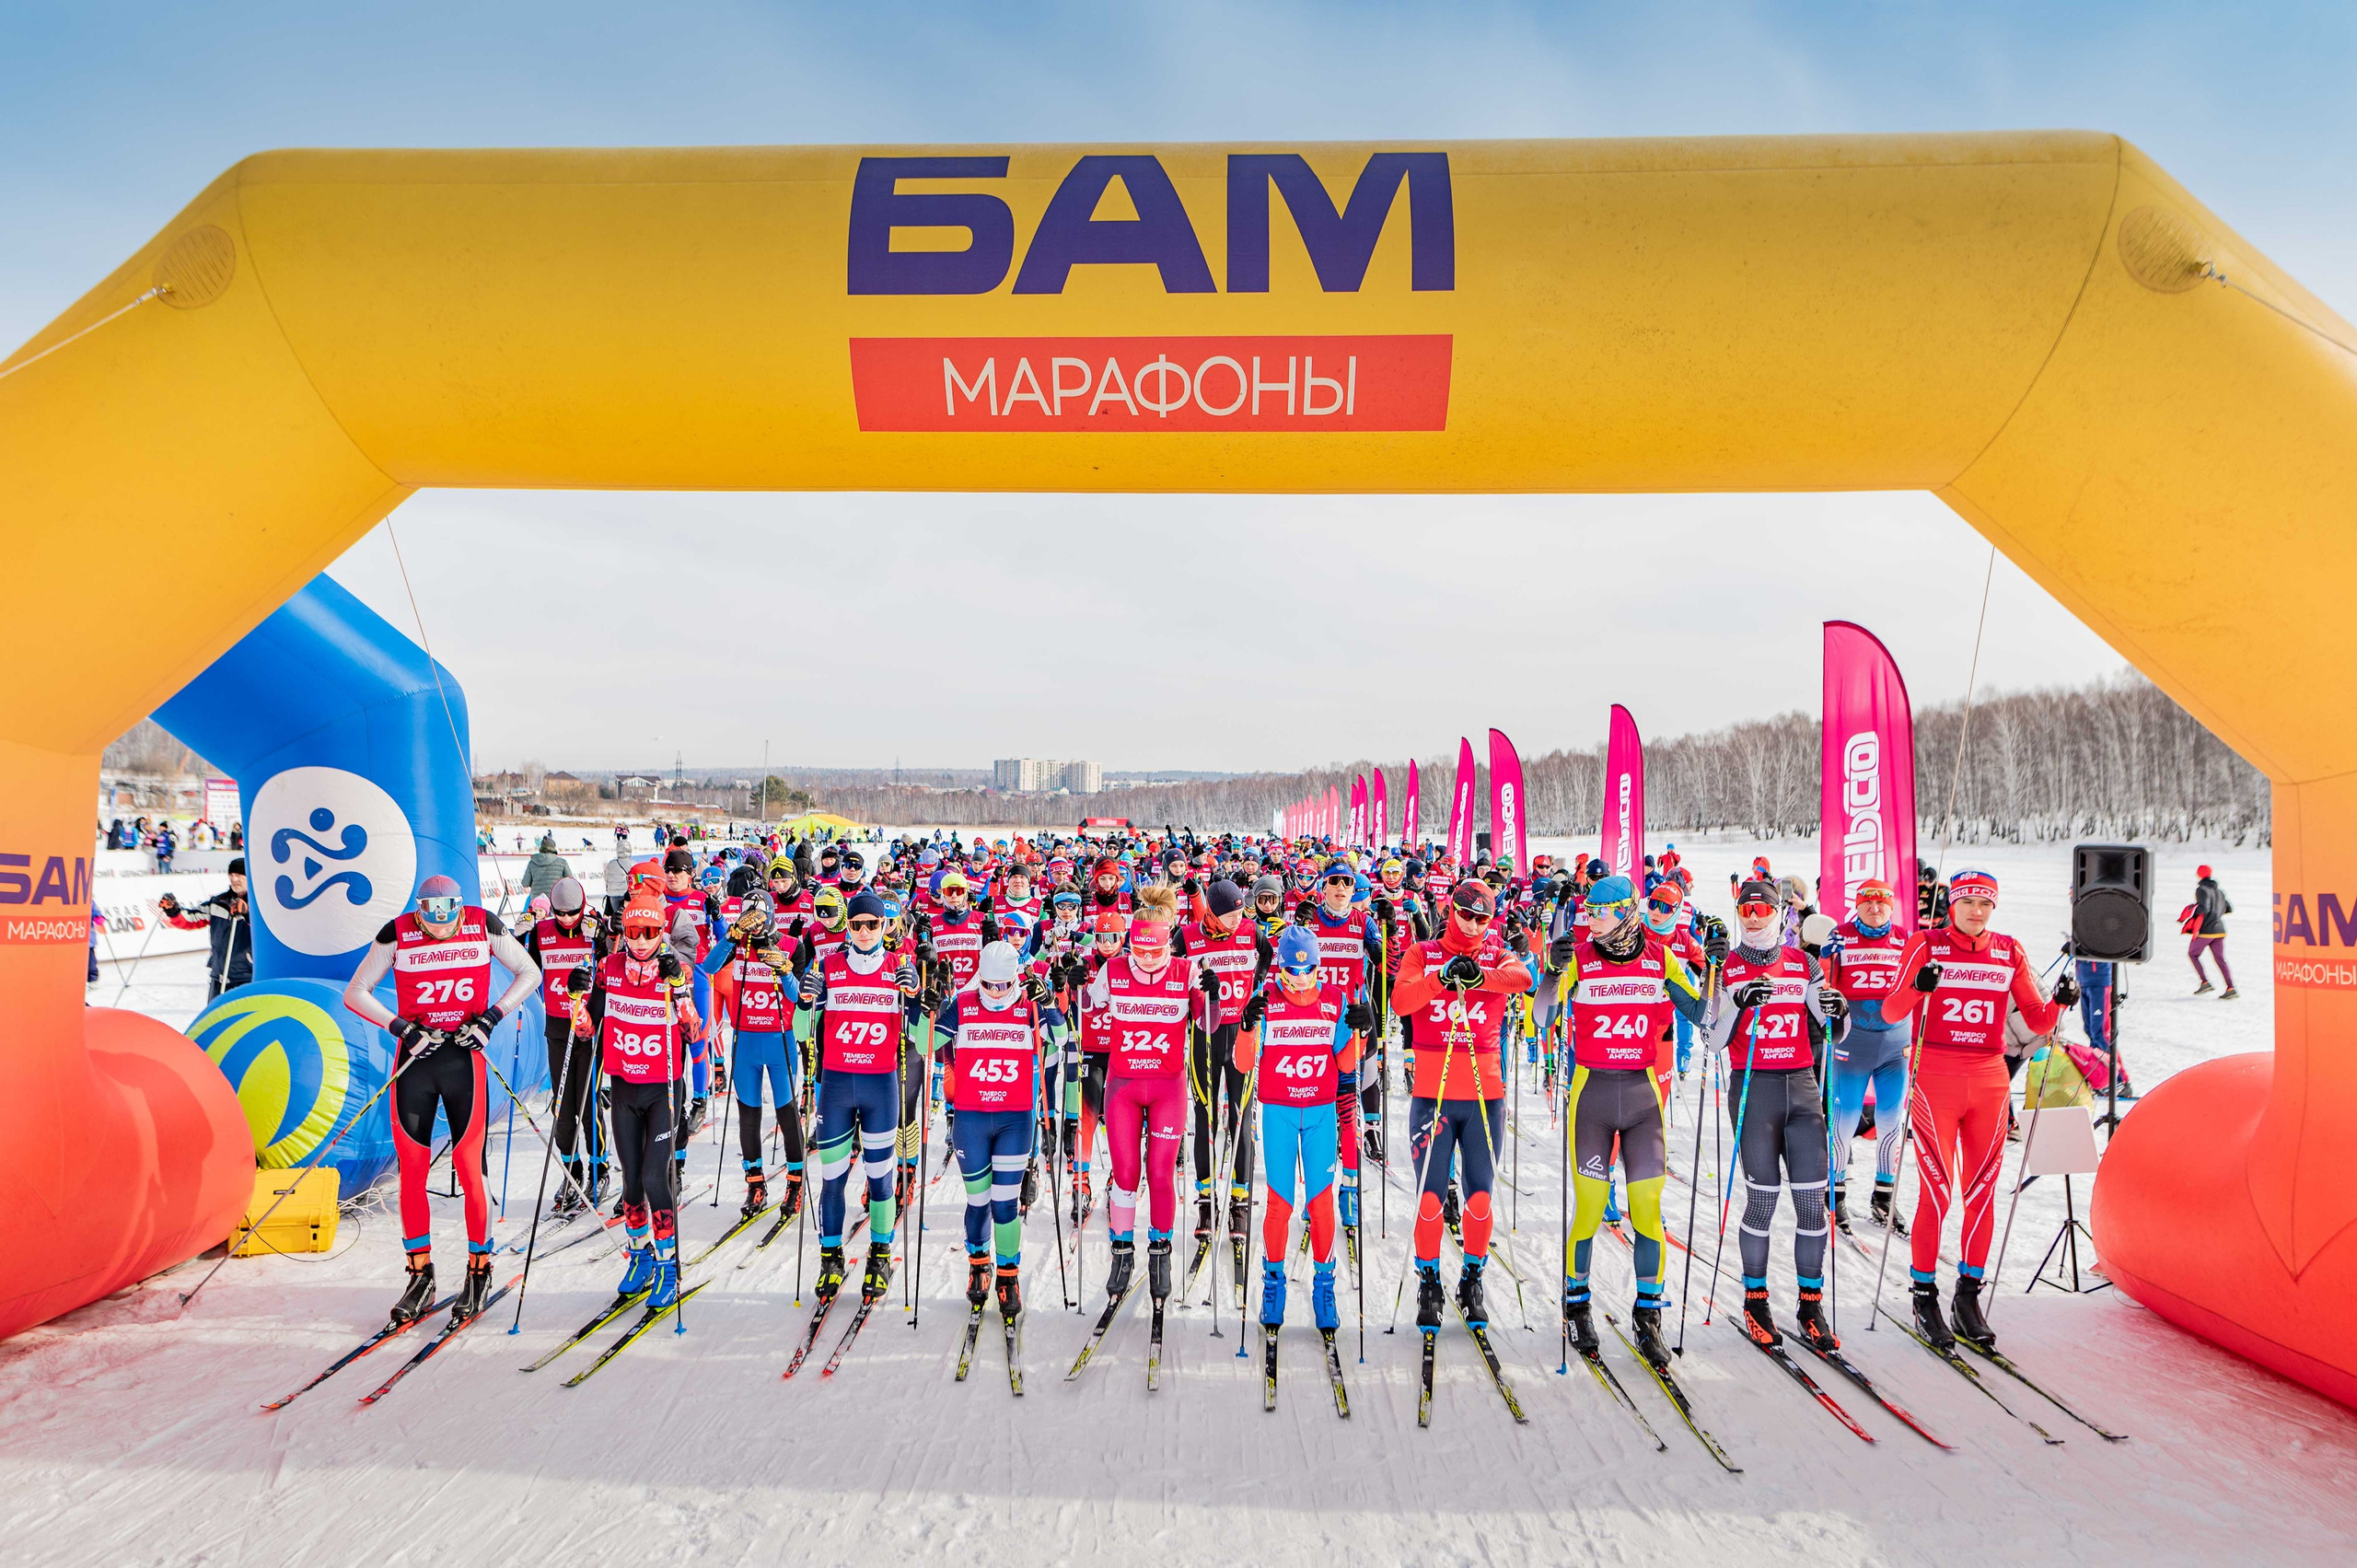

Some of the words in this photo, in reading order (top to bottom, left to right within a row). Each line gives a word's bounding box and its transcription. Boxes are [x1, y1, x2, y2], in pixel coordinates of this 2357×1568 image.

[847, 152, 1455, 295] БАМ
[943, 354, 1357, 418] МАРАФОНЫ
[625, 909, 659, 921] LUKOIL
[883, 902, 898, 912] OIL
[7, 921, 87, 940] МАРАФОНЫ
[1133, 935, 1157, 944] LUKOIL
[409, 948, 479, 965] ТЕМЕРСО
[546, 953, 593, 964] ТЕМЕР
[952, 957, 973, 972] 62
[1318, 967, 1350, 986] 313
[415, 978, 475, 1005] 276
[834, 993, 894, 1006] ТЕМЕРСО
[1219, 981, 1245, 1000] 06
[1589, 983, 1656, 997] ТЕМЕРСО
[741, 990, 783, 1010] 492
[1116, 1002, 1179, 1016] ТЕМЕРСО
[427, 1010, 464, 1018] ТЕМЕРСО
[1943, 998, 1995, 1024] 261
[1090, 1012, 1112, 1030] 39
[1593, 1015, 1648, 1039] 240
[1746, 1014, 1801, 1039] 427
[612, 1028, 662, 1057] 386
[835, 1021, 888, 1045] 479
[967, 1028, 1025, 1042] ТЕМЕРСО
[1120, 1030, 1170, 1054] 324
[621, 1060, 650, 1070] МЕРСО
[970, 1059, 1018, 1083] 453
[1275, 1054, 1328, 1078] 467
[1151, 1132, 1181, 1140] NORDSKI
[1922, 1155, 1939, 1179] CRAFT
